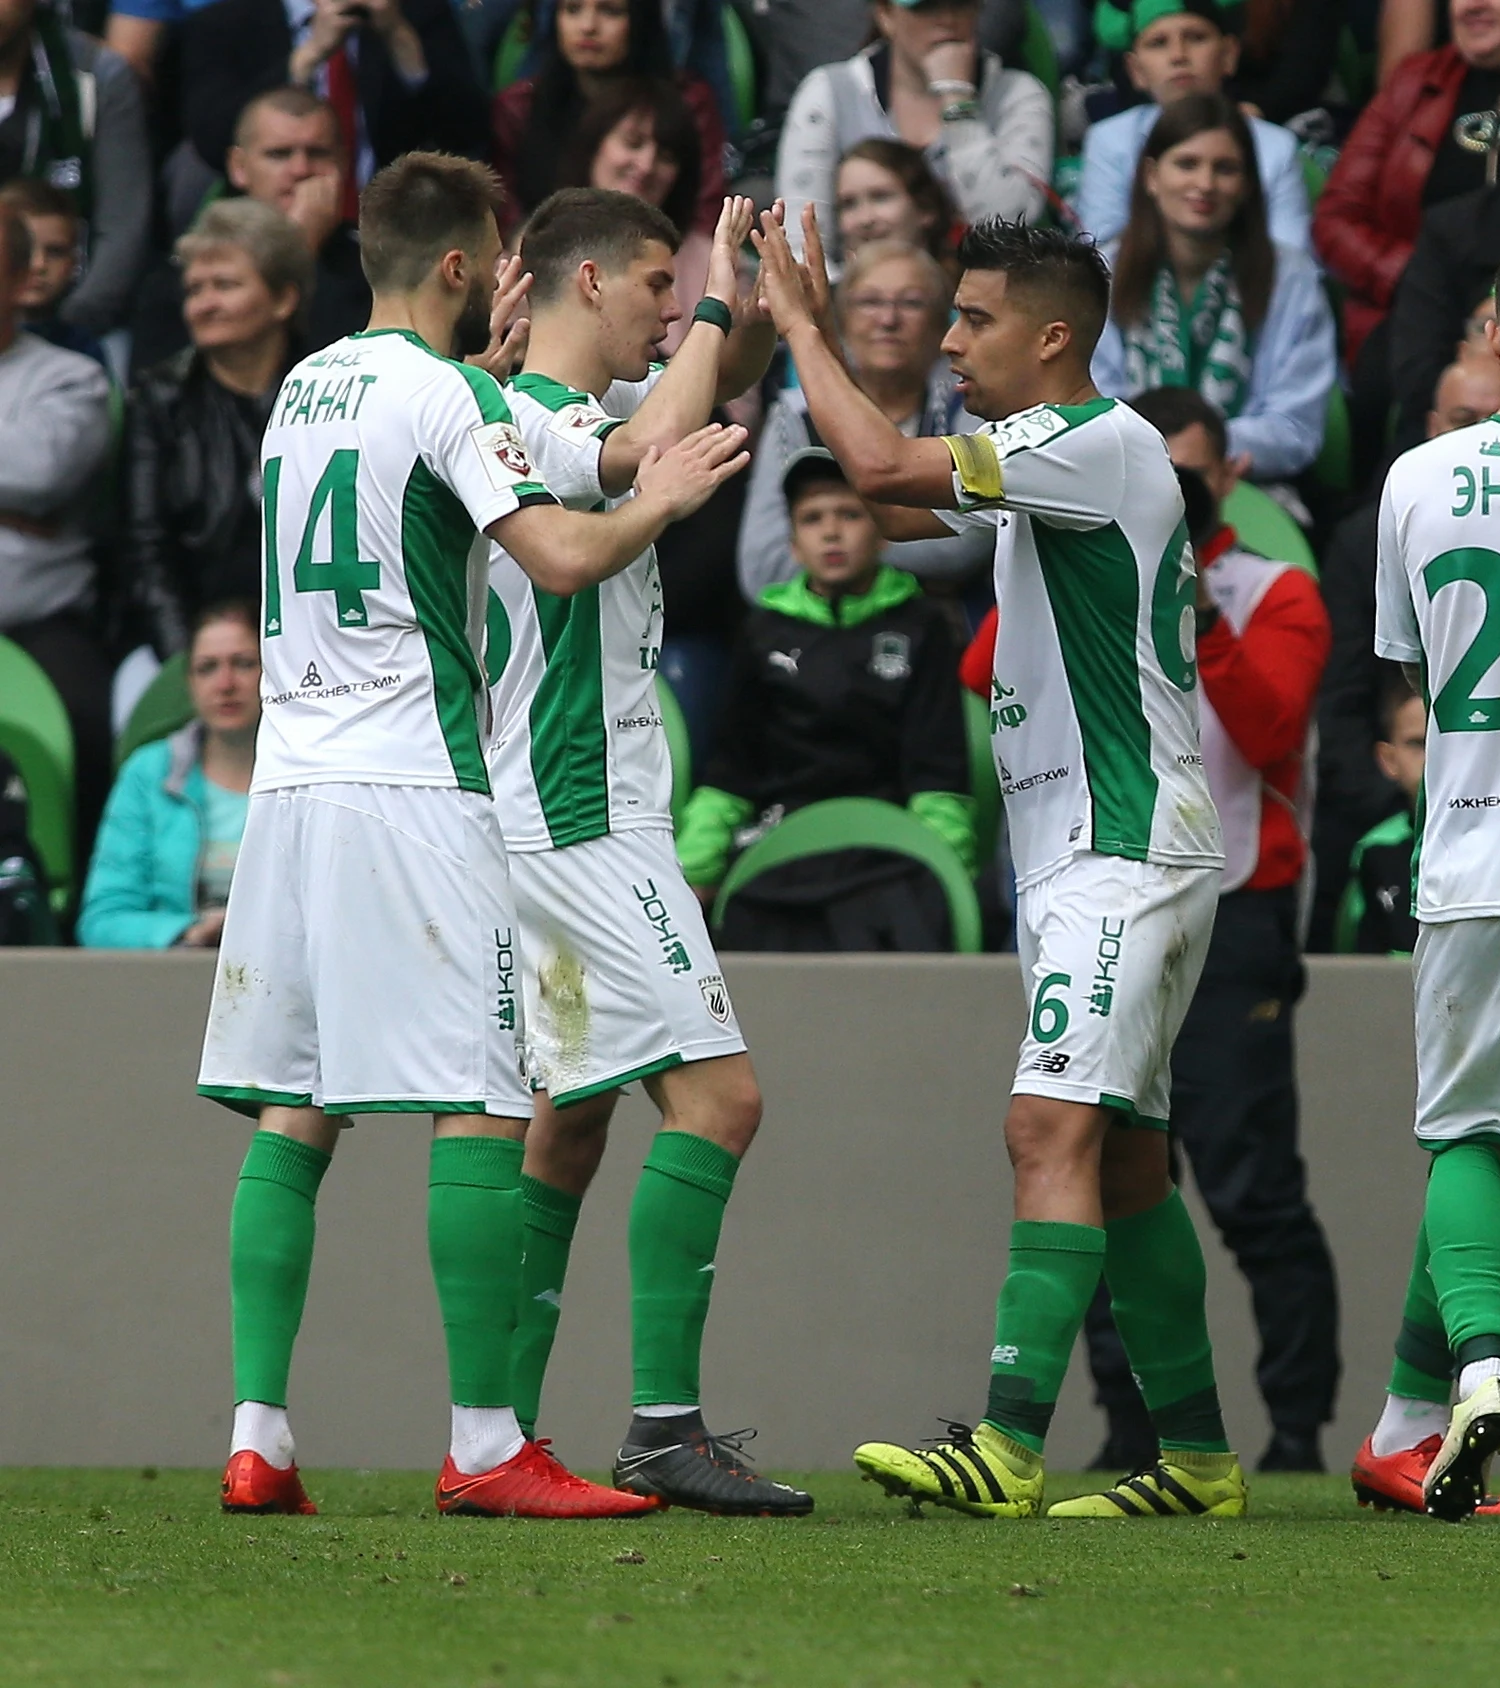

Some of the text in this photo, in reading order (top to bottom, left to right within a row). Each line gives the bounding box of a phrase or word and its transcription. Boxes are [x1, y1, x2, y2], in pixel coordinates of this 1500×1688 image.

[268, 374, 378, 430] ГРАНАТ
[263, 449, 381, 639] 14
[632, 878, 679, 944] КОС
[494, 926, 515, 995] КОС
[1094, 916, 1125, 982] КОС
[1031, 971, 1072, 1045] 6
